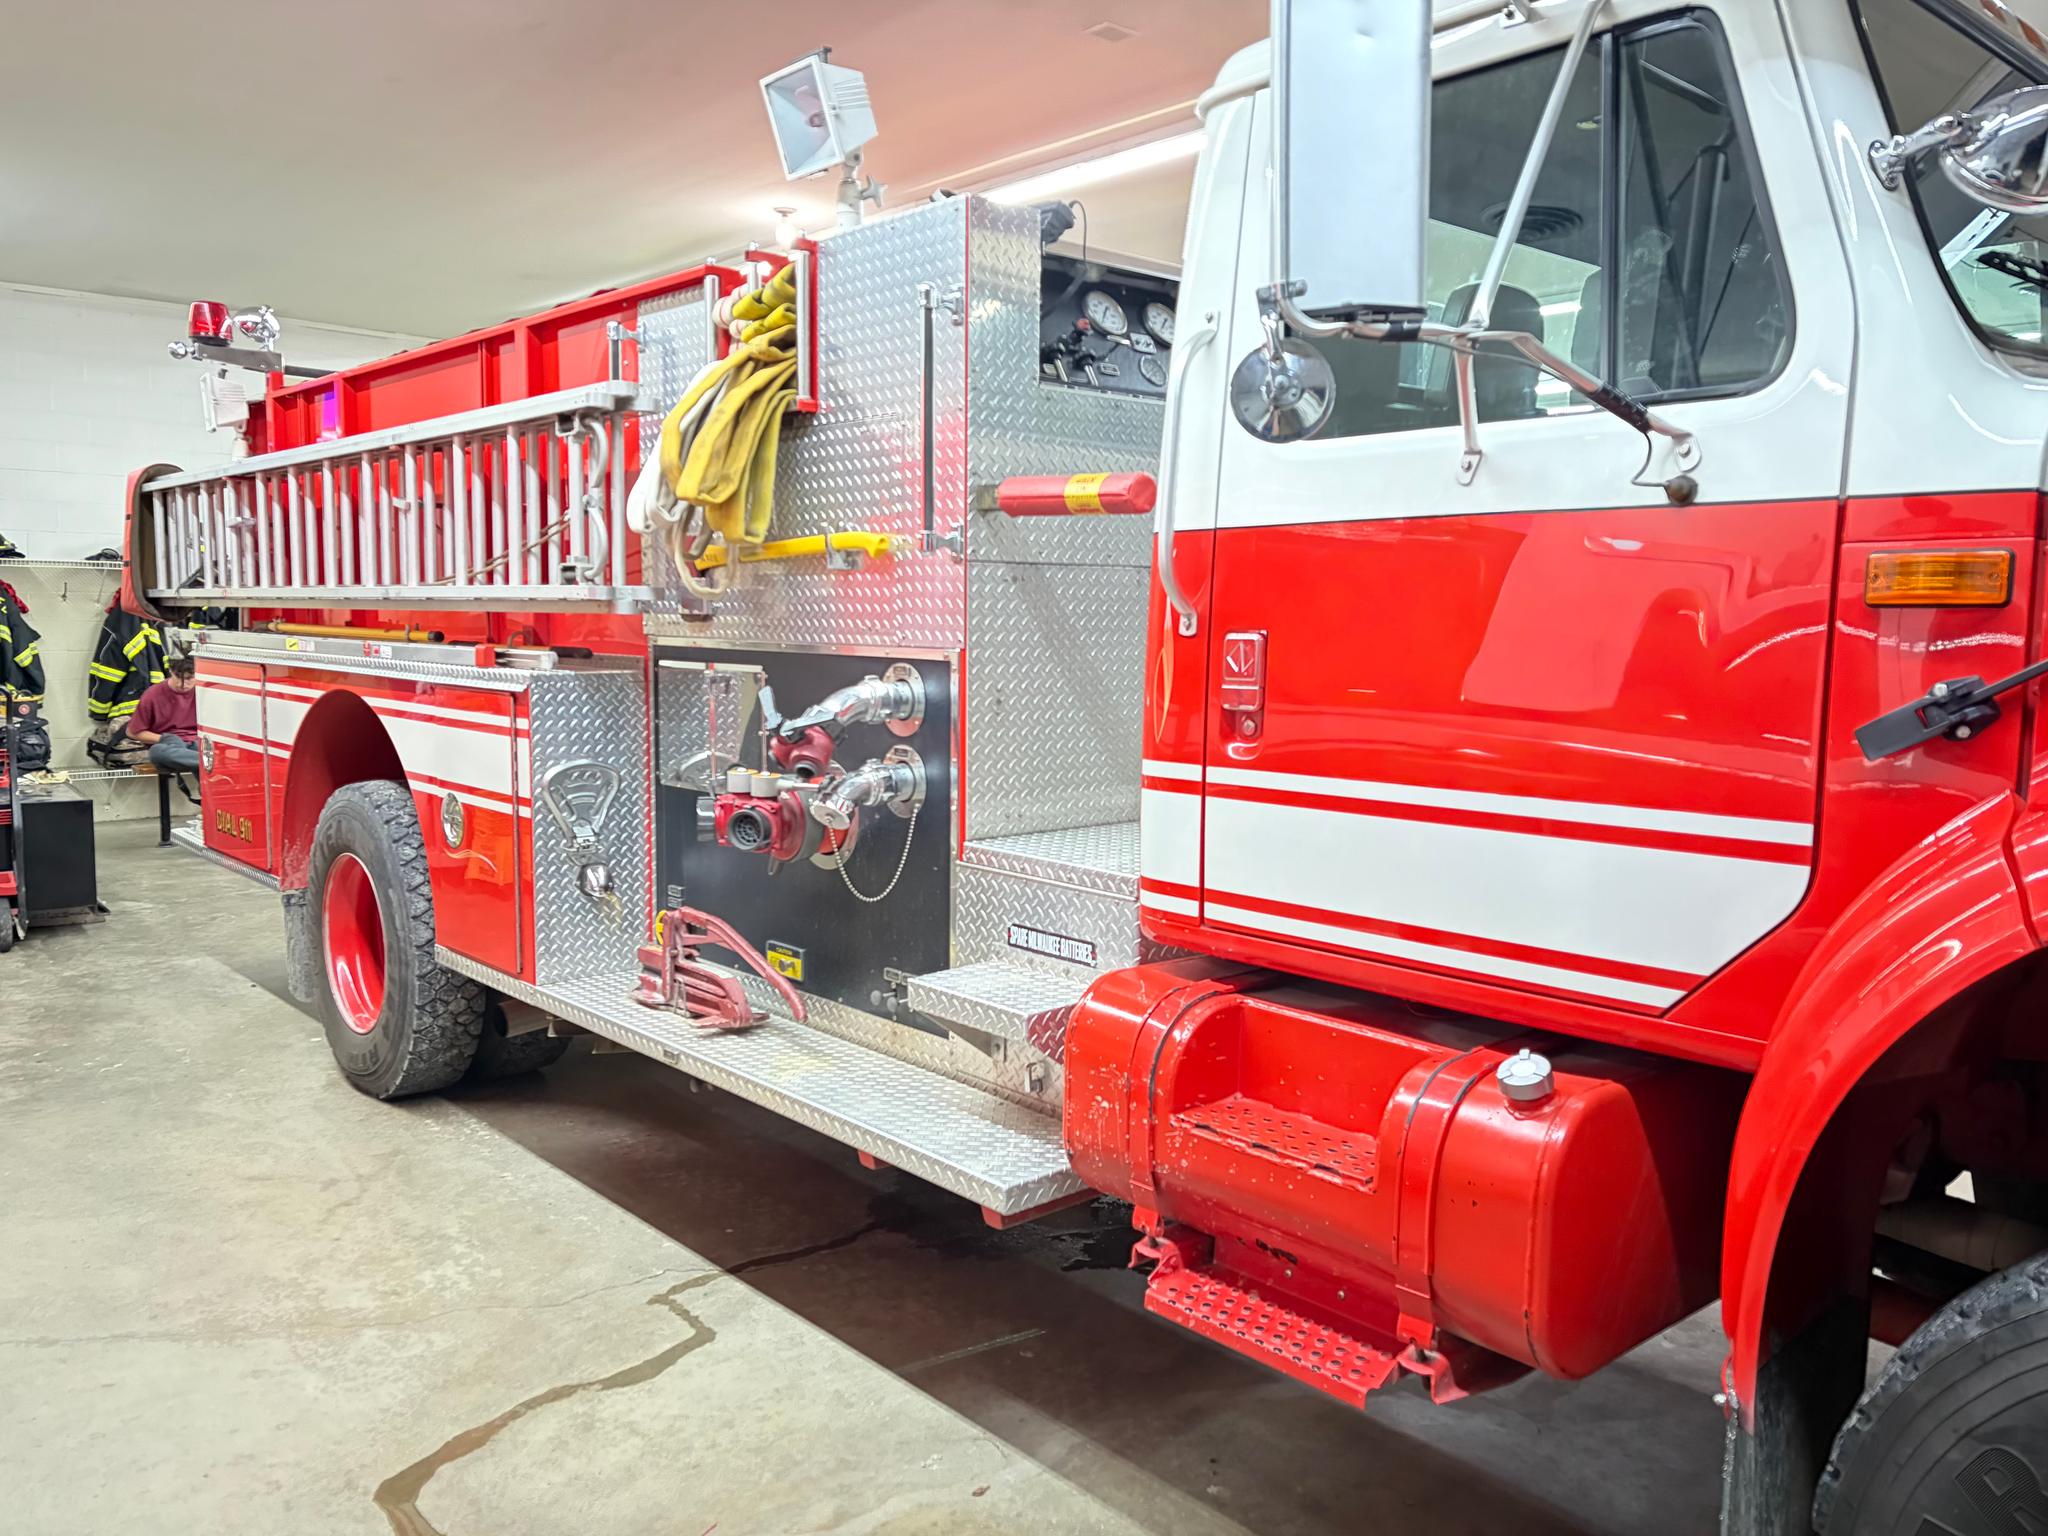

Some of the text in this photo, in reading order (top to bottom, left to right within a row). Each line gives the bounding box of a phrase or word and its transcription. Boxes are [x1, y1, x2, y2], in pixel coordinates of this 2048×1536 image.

[216, 809, 252, 842] DIAL 911
[1010, 926, 1028, 946] SPARE
[1061, 939, 1093, 962] BATTERIES
